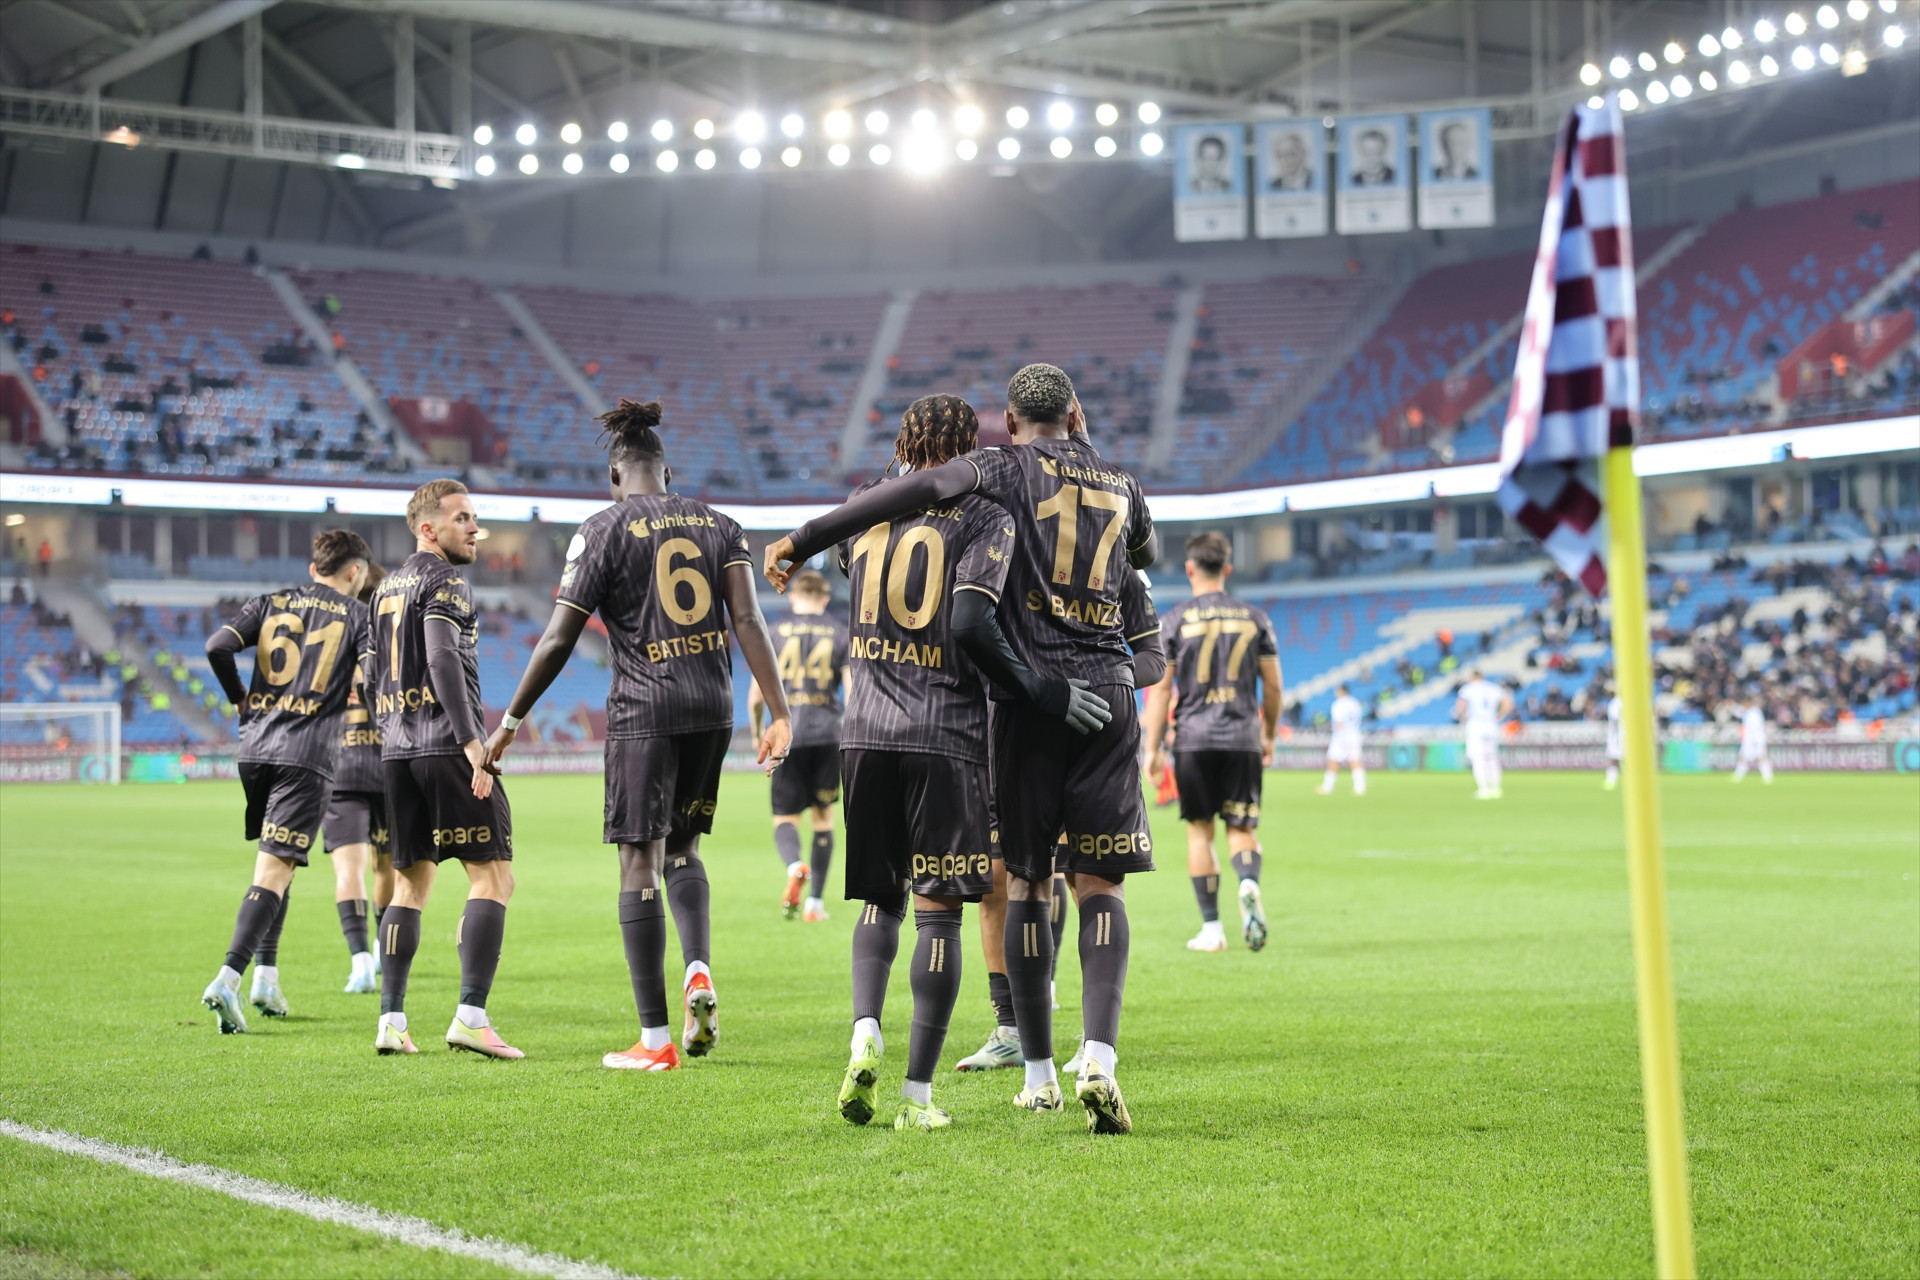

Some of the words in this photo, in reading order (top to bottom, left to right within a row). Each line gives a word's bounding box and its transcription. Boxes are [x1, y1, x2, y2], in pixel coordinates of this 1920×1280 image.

[1061, 467, 1128, 489] whitebit
[651, 513, 715, 530] whitebit
[1037, 484, 1128, 591] 17
[656, 537, 711, 626] 6
[853, 521, 944, 630] 10
[289, 596, 348, 616] whitebit
[257, 612, 346, 694] 61
[378, 593, 405, 681] 7
[777, 635, 834, 689] 44
[1181, 619, 1257, 684] 77
[912, 853, 990, 881] papara
[1068, 831, 1151, 860] papara
